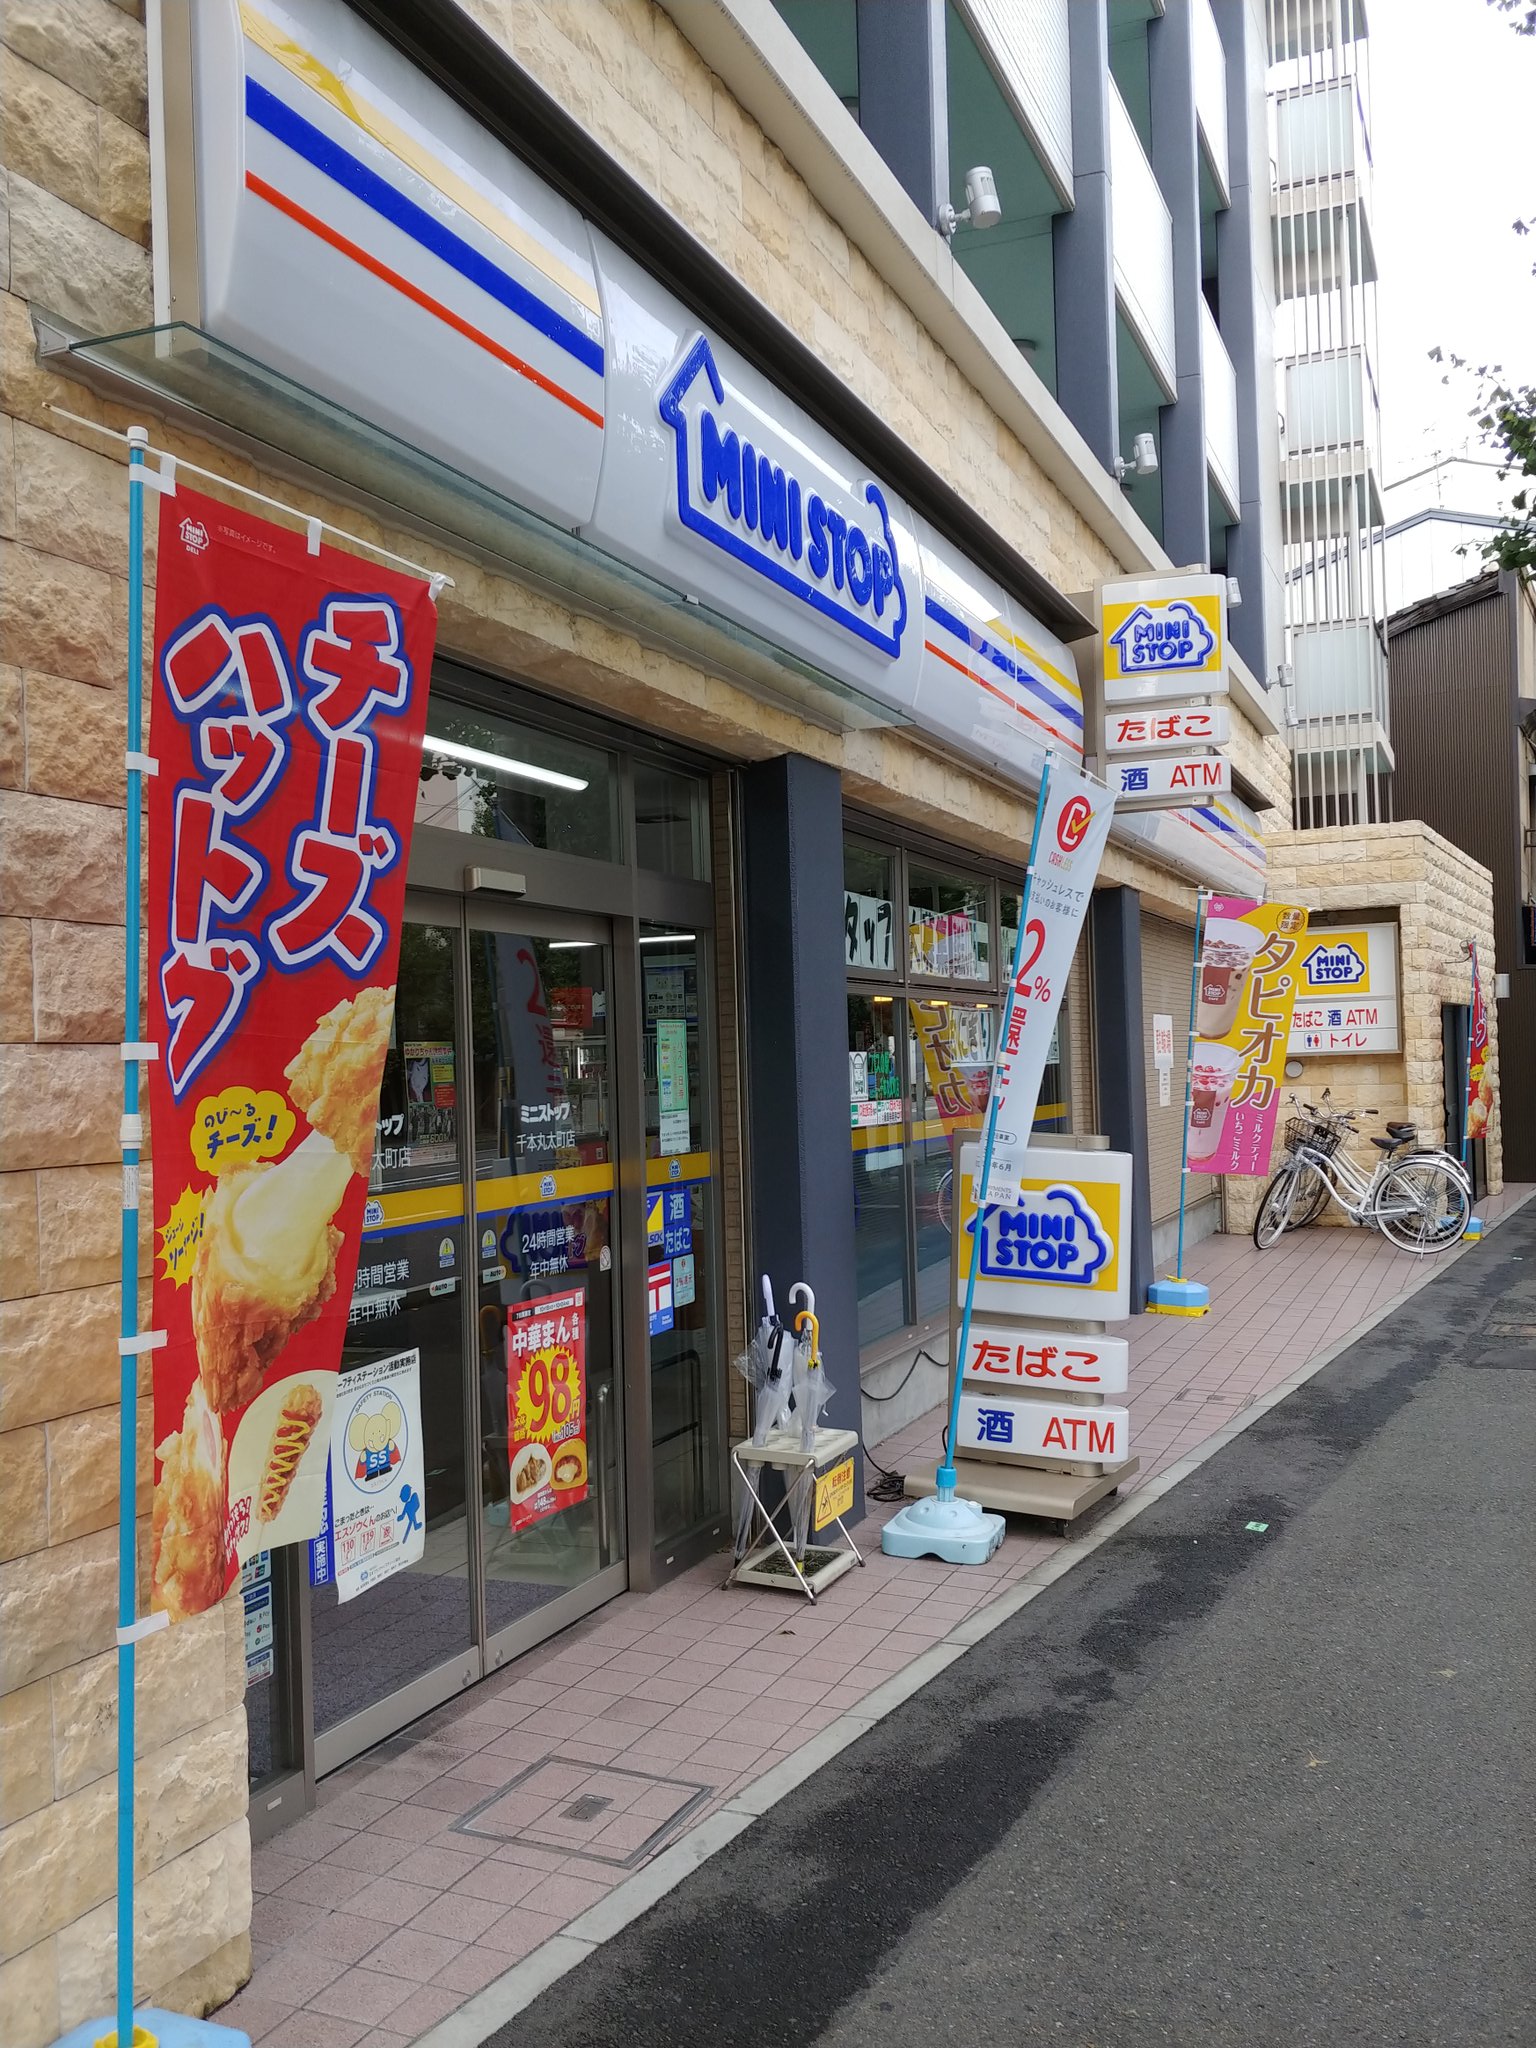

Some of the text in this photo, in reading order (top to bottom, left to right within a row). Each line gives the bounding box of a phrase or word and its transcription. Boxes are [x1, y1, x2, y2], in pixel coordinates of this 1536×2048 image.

[701, 408, 894, 618] MINI STOP
[184, 533, 204, 545] STOP
[185, 523, 204, 537] MINI
[1133, 619, 1190, 643] MINI
[1132, 640, 1194, 664] STOP
[1117, 714, 1213, 743] たばこ
[265, 597, 408, 977] チーズ
[1121, 763, 1222, 792] 酒 ATM
[160, 616, 296, 1101] ハットグ
[1315, 967, 1353, 980] STOP
[1316, 954, 1351, 967] MINI
[1231, 932, 1298, 1111] タピオカ
[1292, 1008, 1378, 1028] たばこ 酒 ATM
[1330, 1032, 1368, 1048] トイレ
[520, 1101, 571, 1123] ミニストップ
[515, 1130, 576, 1152] 千本丸太町店
[1230, 1112, 1245, 1171] いちごミルク
[1251, 1113, 1264, 1172] ミルクティー
[371, 1146, 412, 1170] 太町店
[669, 1193, 685, 1221] 酒
[987, 1191, 1011, 1200] APAN
[365, 1214, 381, 1223] STOP
[366, 1207, 379, 1216] MINI
[165, 1218, 184, 1244] ジューシ
[522, 1224, 575, 1254] 24時間営業
[999, 1210, 1076, 1243] MINI
[665, 1226, 691, 1254] たばこ
[996, 1238, 1079, 1270] STOP
[528, 1255, 569, 1281] 年中無休
[347, 1297, 401, 1326] 年中無休
[512, 1315, 570, 1357] 中華まん
[571, 1312, 580, 1341] 各種
[972, 1340, 1101, 1382] たばこ
[354, 1390, 393, 1413] SAFETY STATION
[528, 1352, 572, 1433] 98
[976, 1408, 1115, 1454] 酒 ATM
[369, 1450, 387, 1468] SS
[342, 1539, 355, 1553] 110
[362, 1530, 375, 1543] 119
